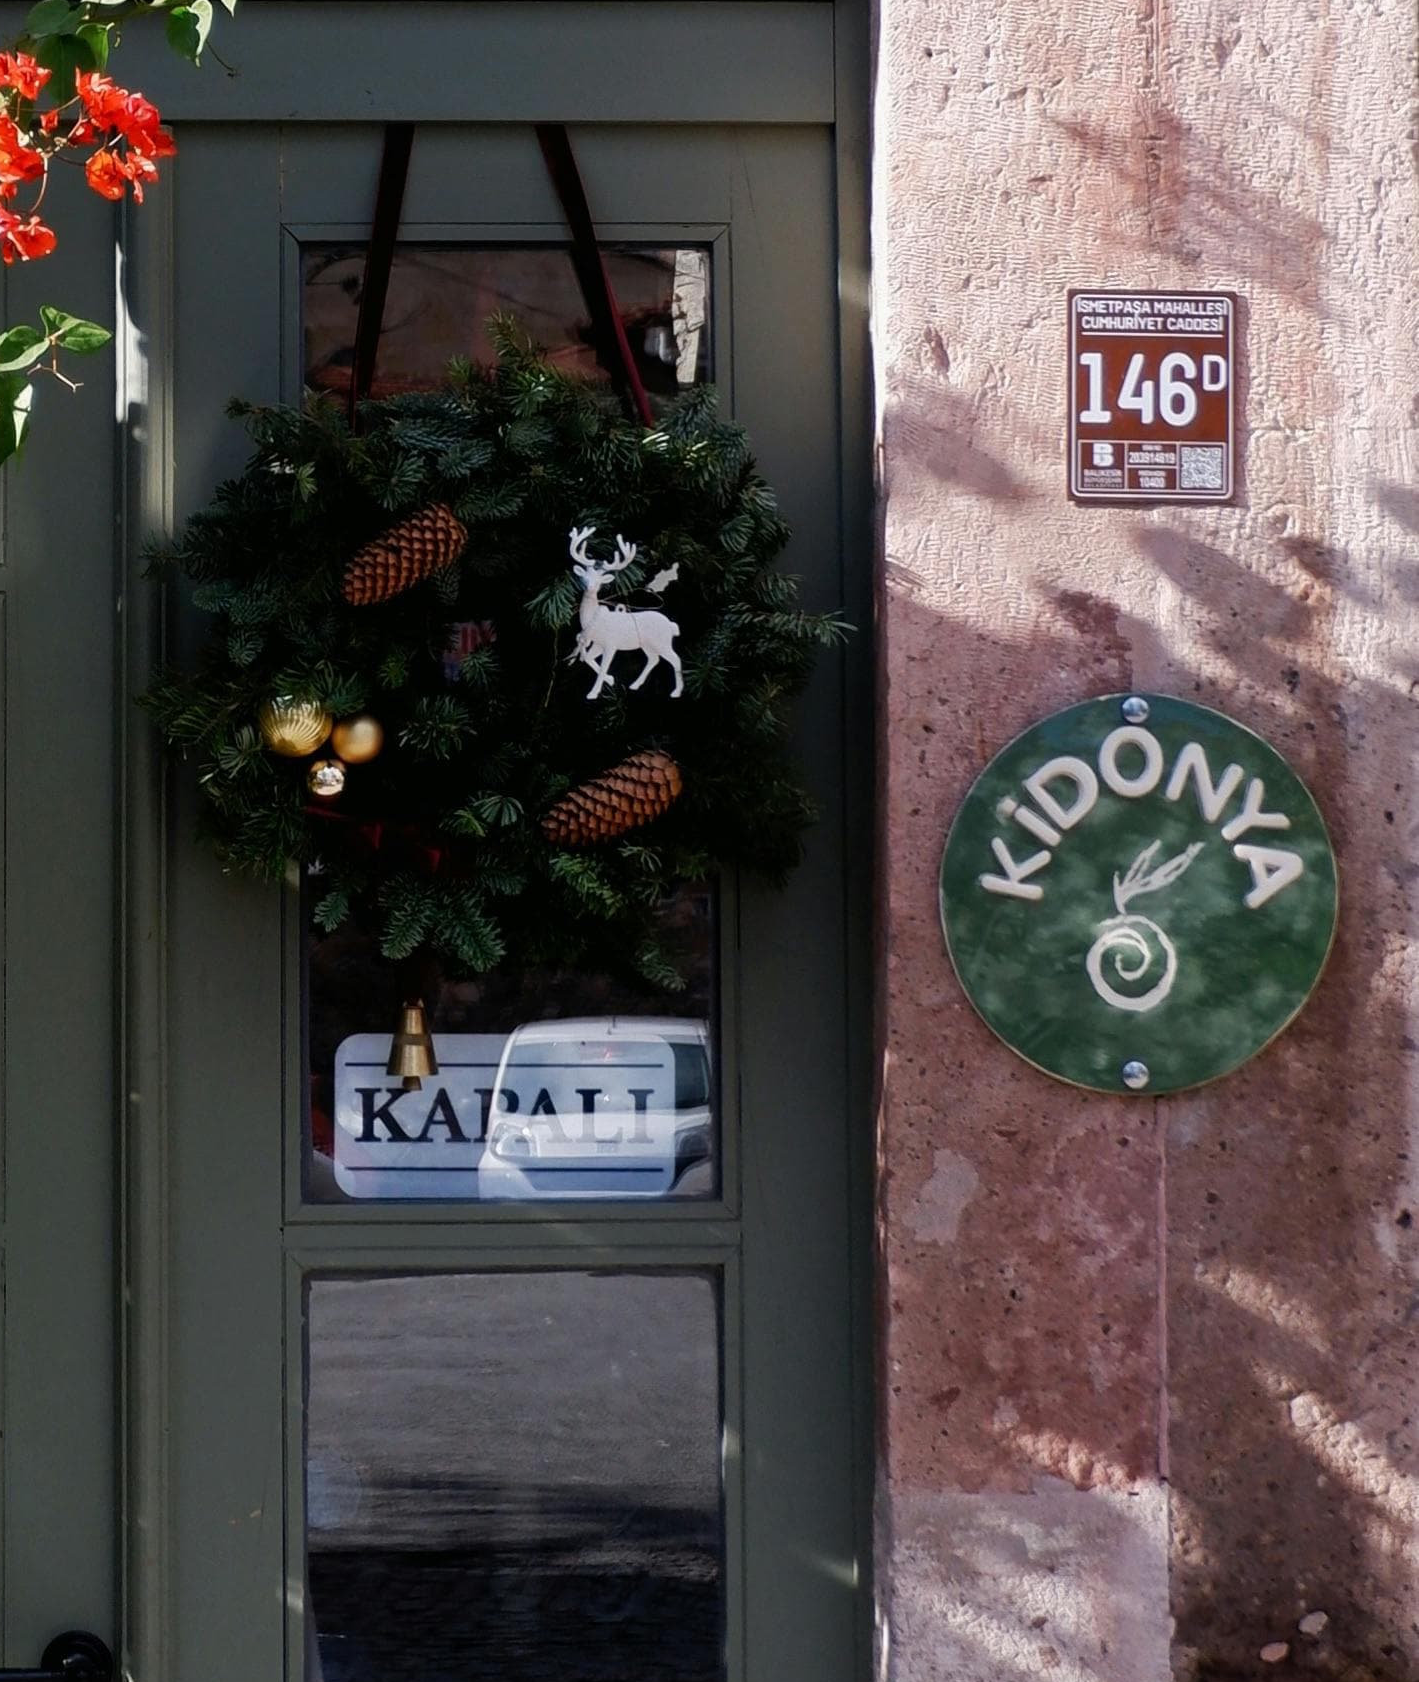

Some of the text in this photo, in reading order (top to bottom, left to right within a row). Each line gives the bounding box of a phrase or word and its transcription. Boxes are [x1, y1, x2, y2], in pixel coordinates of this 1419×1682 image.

[1076, 298, 1228, 318] İSMETPAŞA MAHALLESİ
[1081, 315, 1224, 332] CUMHURİYET CADDESİ
[353, 1087, 656, 1144] KAPALI
